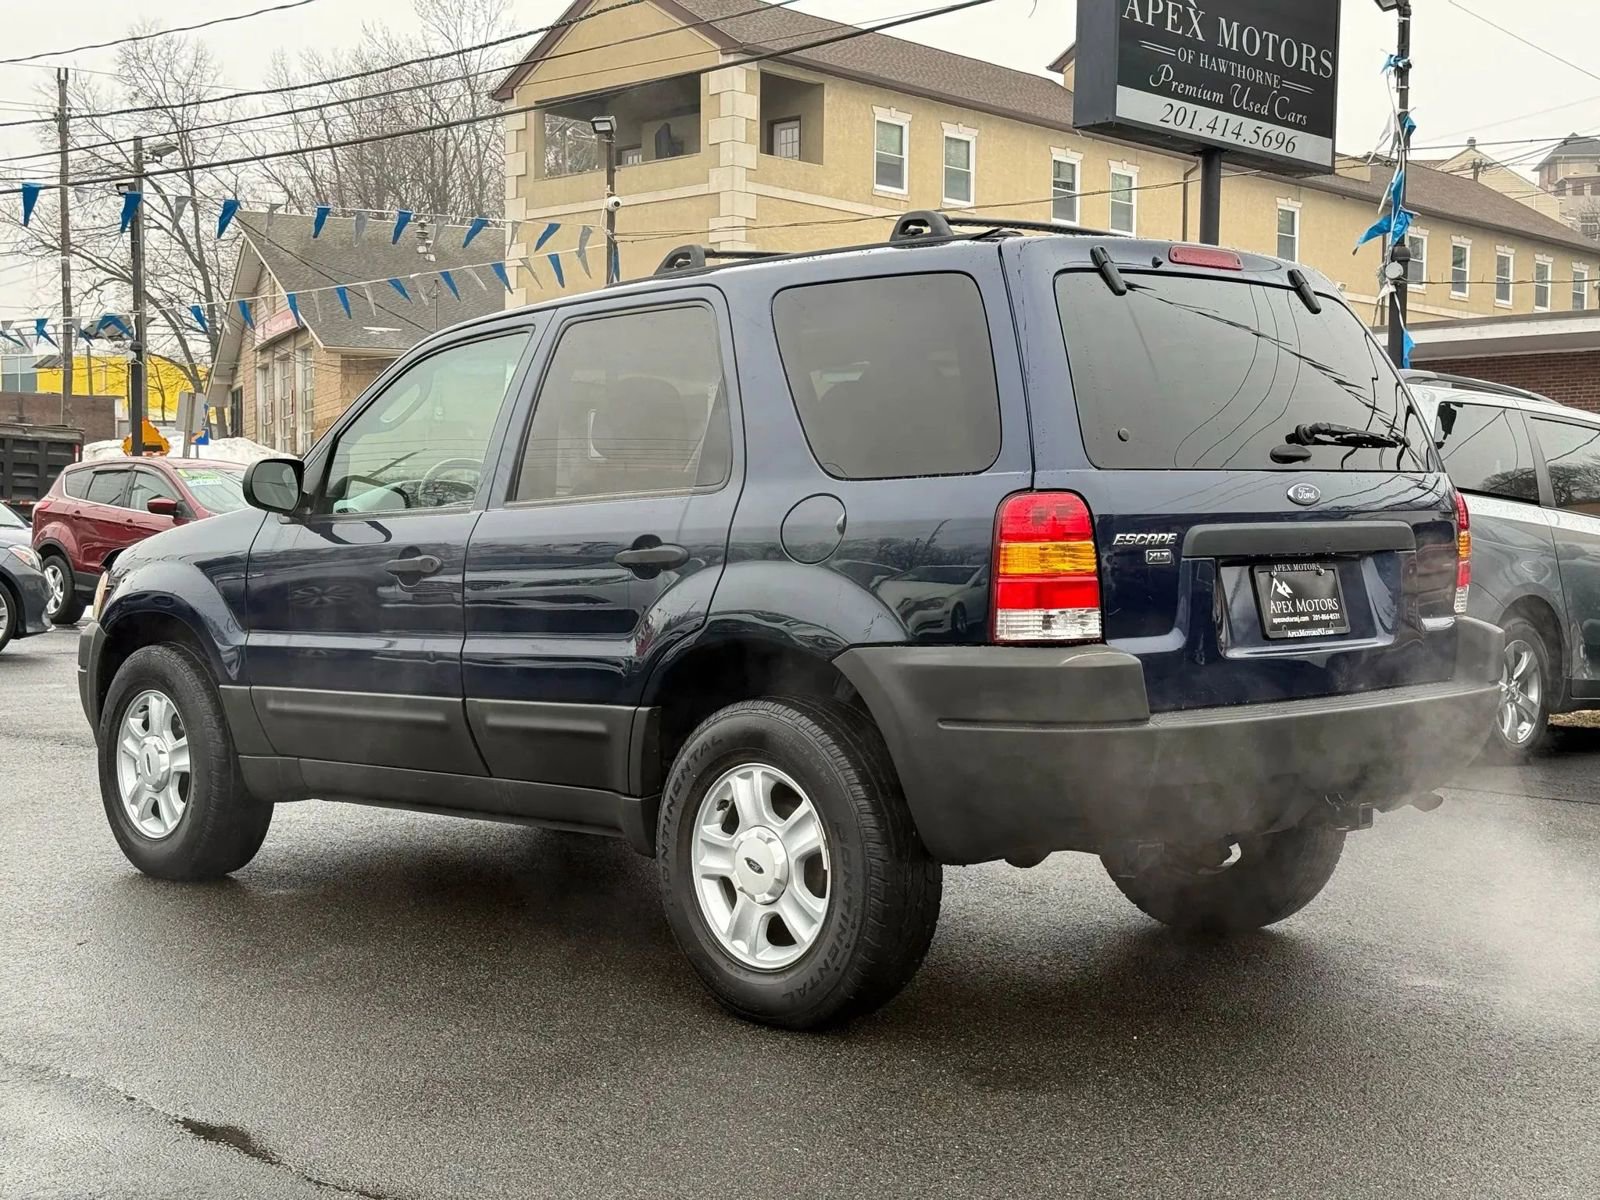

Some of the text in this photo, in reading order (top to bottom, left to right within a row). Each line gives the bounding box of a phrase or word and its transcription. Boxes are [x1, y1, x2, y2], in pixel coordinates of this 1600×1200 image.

[1122, 0, 1333, 78] APEX MOTORS
[1178, 47, 1282, 89] OF HAWTHORNE
[1150, 64, 1308, 126] Premium Used Cars
[1160, 103, 1299, 154] 201.414.5696
[1112, 533, 1178, 546] ESCAPE
[1273, 563, 1321, 572] APEX MOTORS
[1270, 598, 1339, 614] APEX MOTORS
